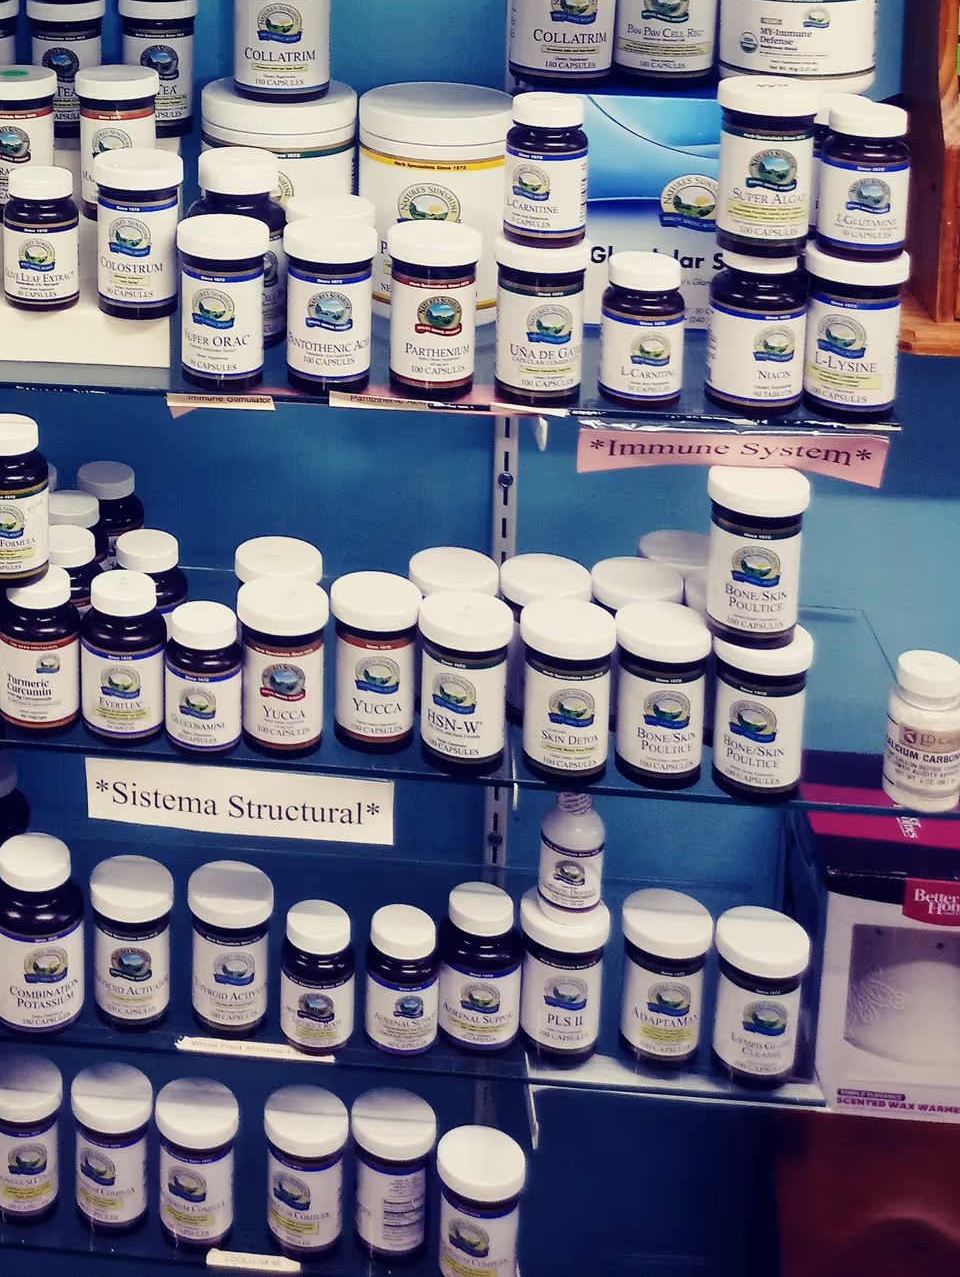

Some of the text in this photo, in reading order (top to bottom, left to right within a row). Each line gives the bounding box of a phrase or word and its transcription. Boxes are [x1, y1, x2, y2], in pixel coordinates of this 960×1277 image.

[532, 28, 607, 44] COLLATRIM
[760, 35, 794, 46] Defense
[244, 46, 316, 63] COLLATRIM
[100, 256, 163, 272] COLOSTRUM
[7, 673, 49, 688] Turmeric
[7, 683, 52, 696] Curcumin
[263, 705, 306, 720] YUCCA
[353, 698, 402, 715] YUCCA
[914, 888, 960, 904] Better
